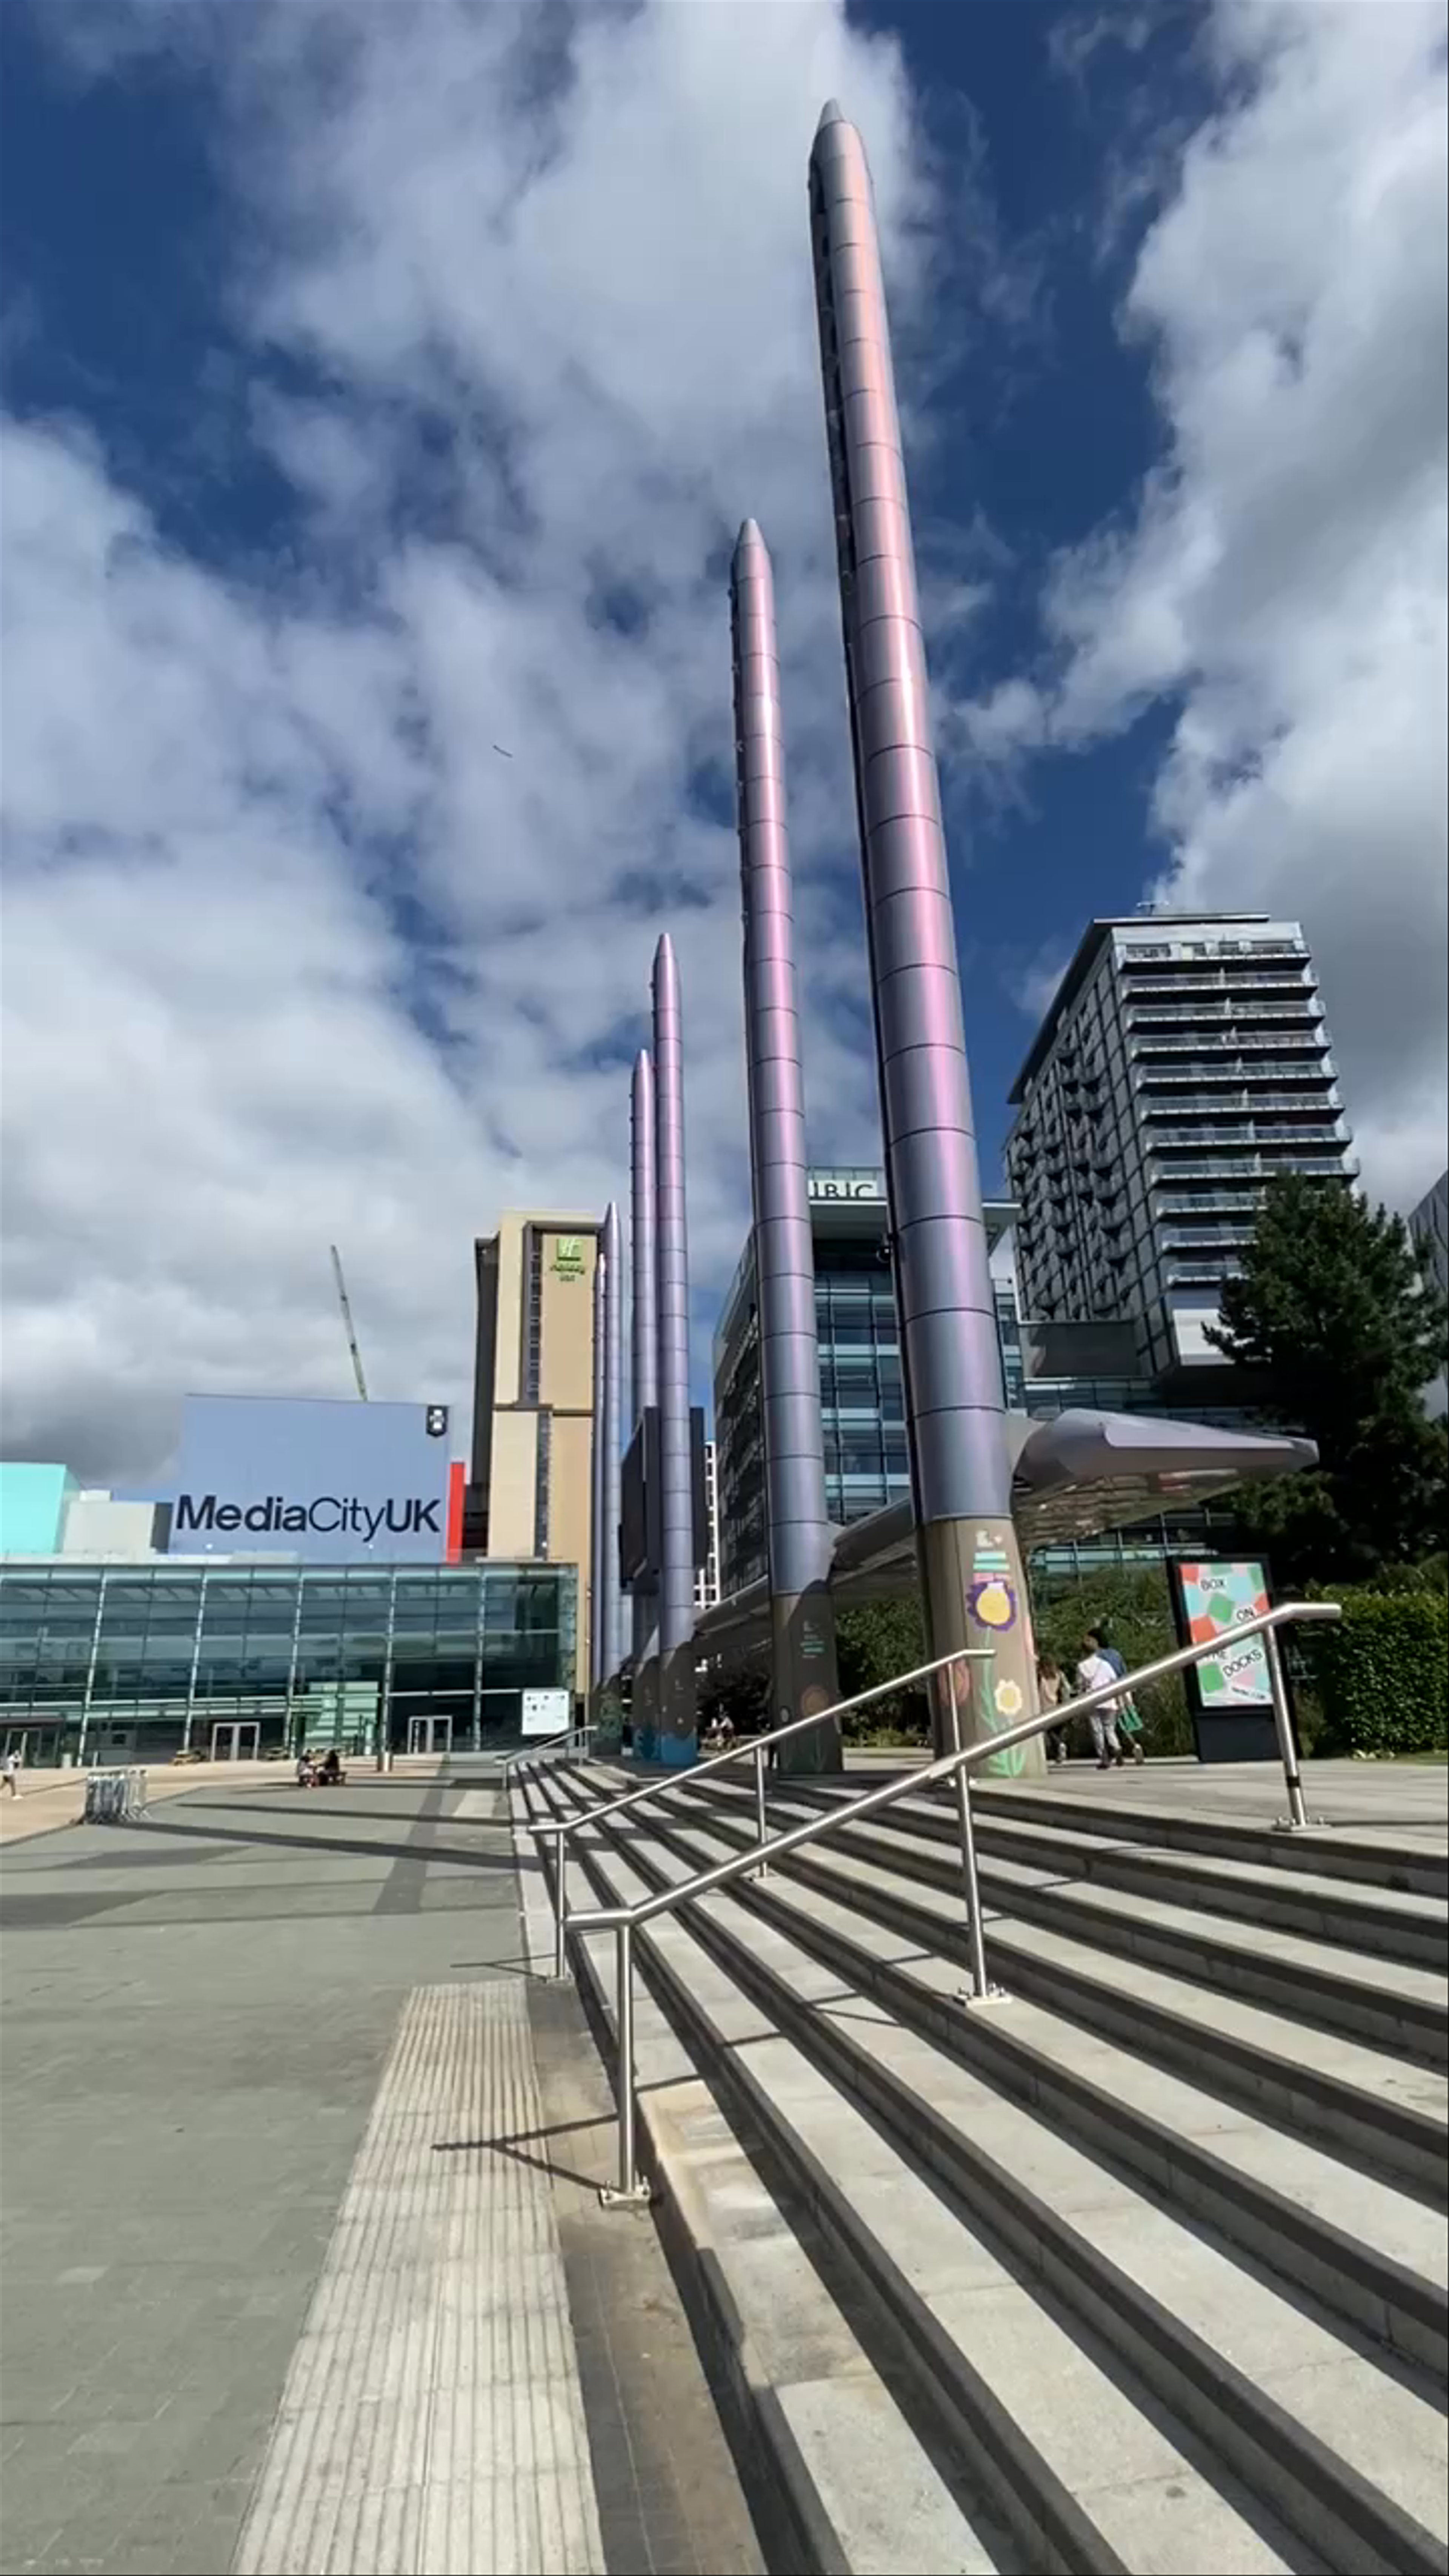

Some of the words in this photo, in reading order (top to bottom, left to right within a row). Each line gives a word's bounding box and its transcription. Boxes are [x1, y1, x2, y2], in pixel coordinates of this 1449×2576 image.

[175, 1494, 441, 1543] MediaCityUK
[1200, 1578, 1225, 1591] BOX
[1236, 1607, 1255, 1621] ON
[1222, 1649, 1263, 1677] DOCKS
